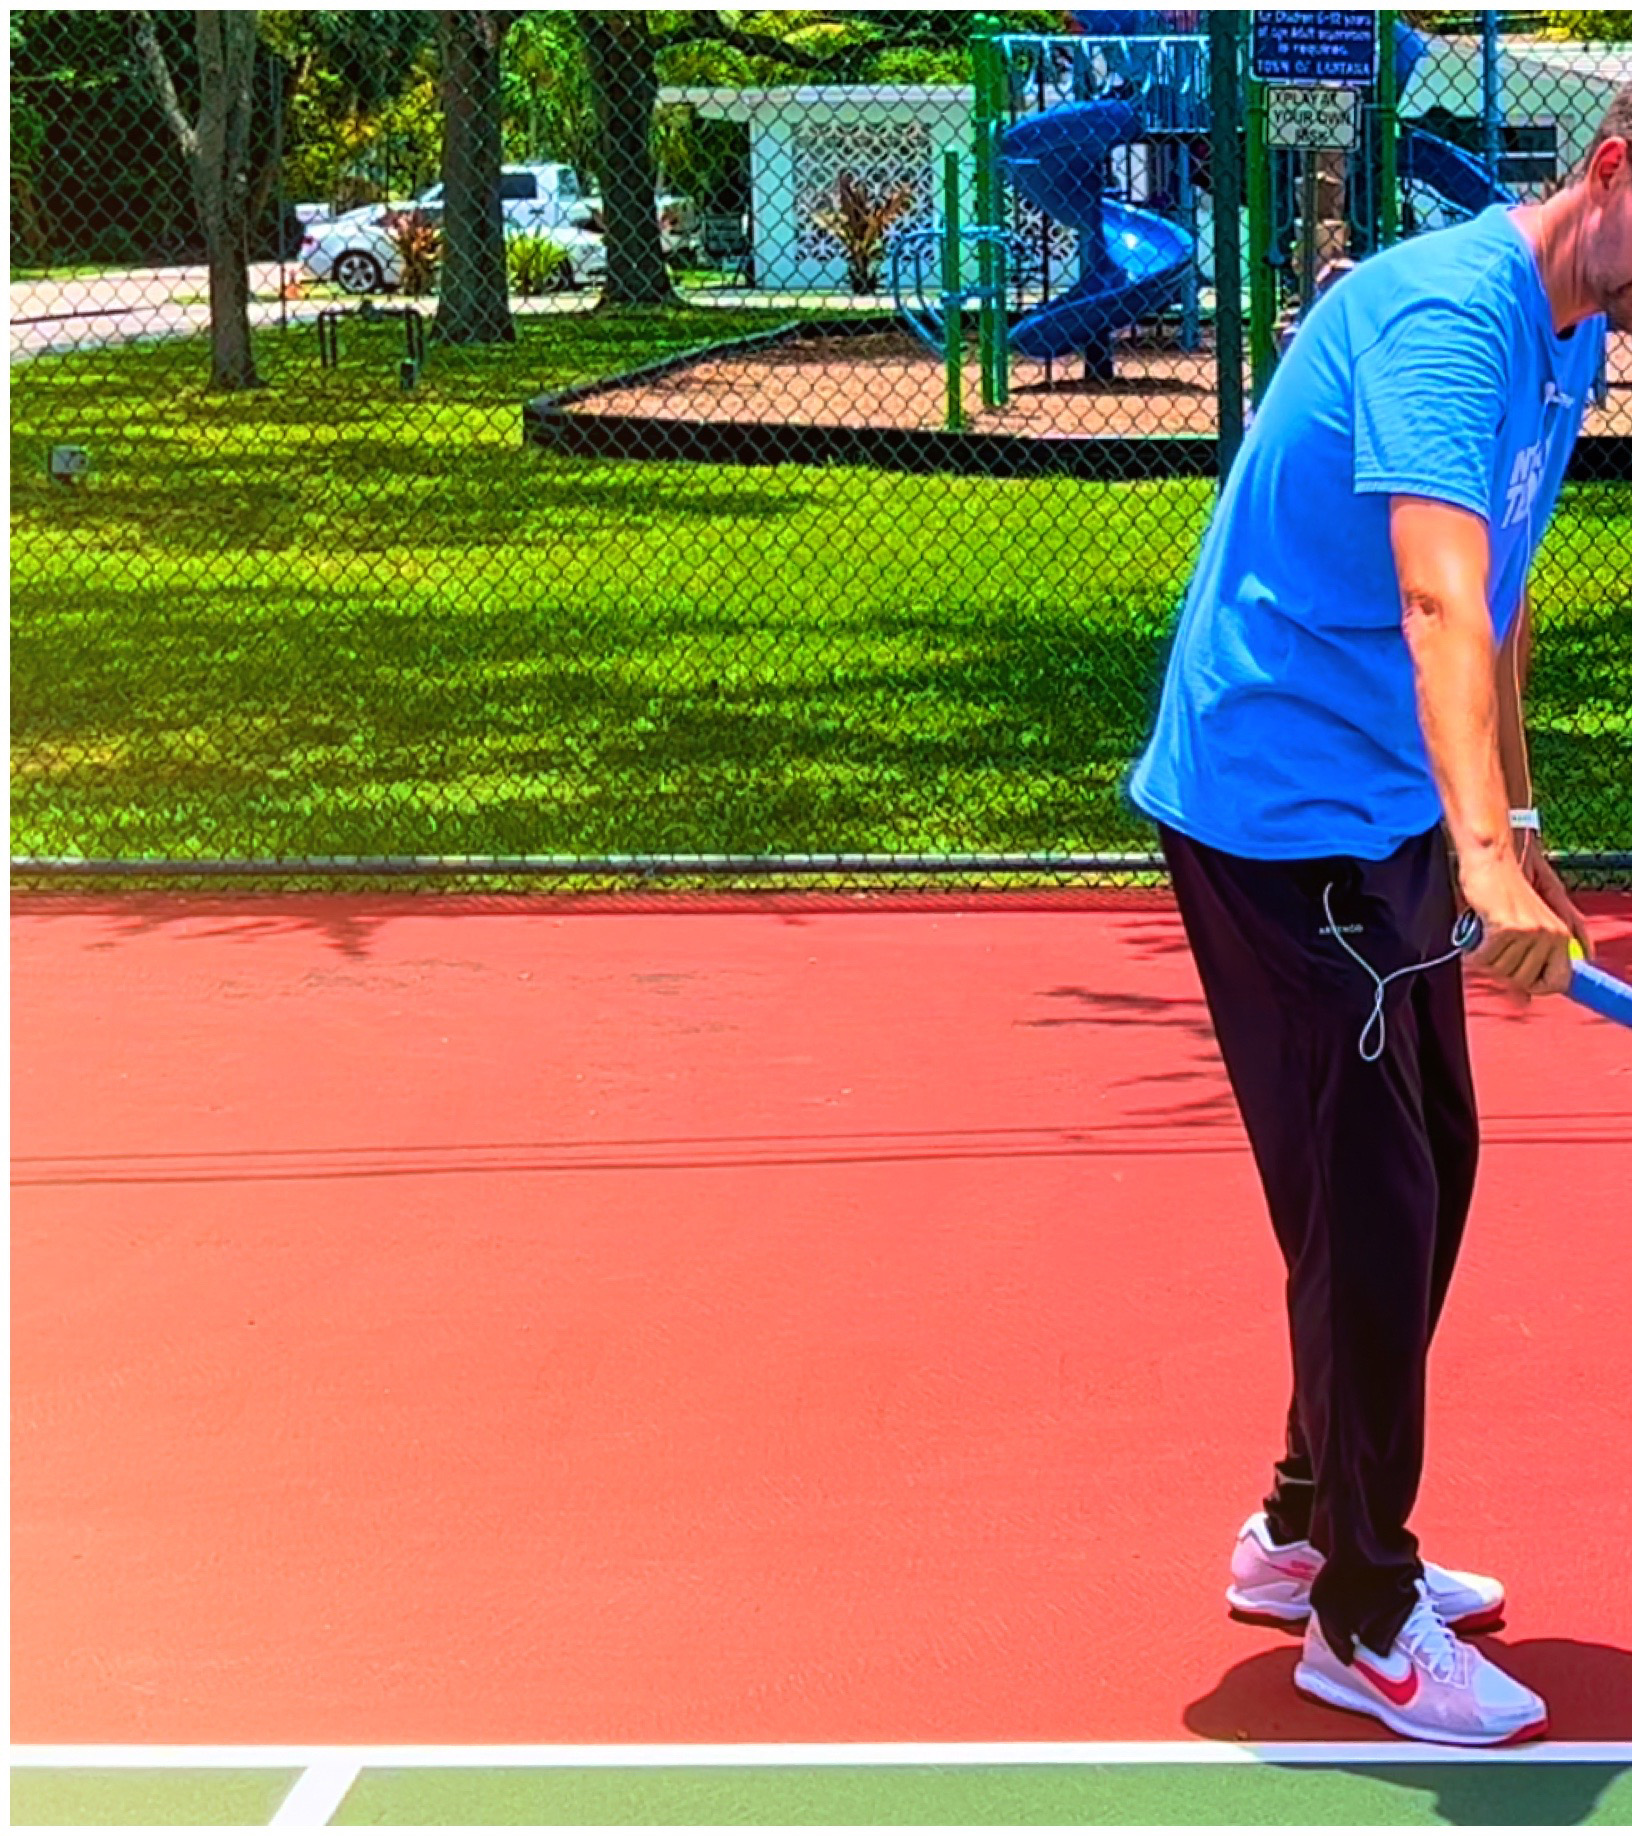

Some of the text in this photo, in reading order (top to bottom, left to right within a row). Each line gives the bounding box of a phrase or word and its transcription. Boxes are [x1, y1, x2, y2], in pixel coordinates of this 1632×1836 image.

[1274, 109, 1351, 126] YOUR OWN
[1295, 128, 1328, 142] RISK
